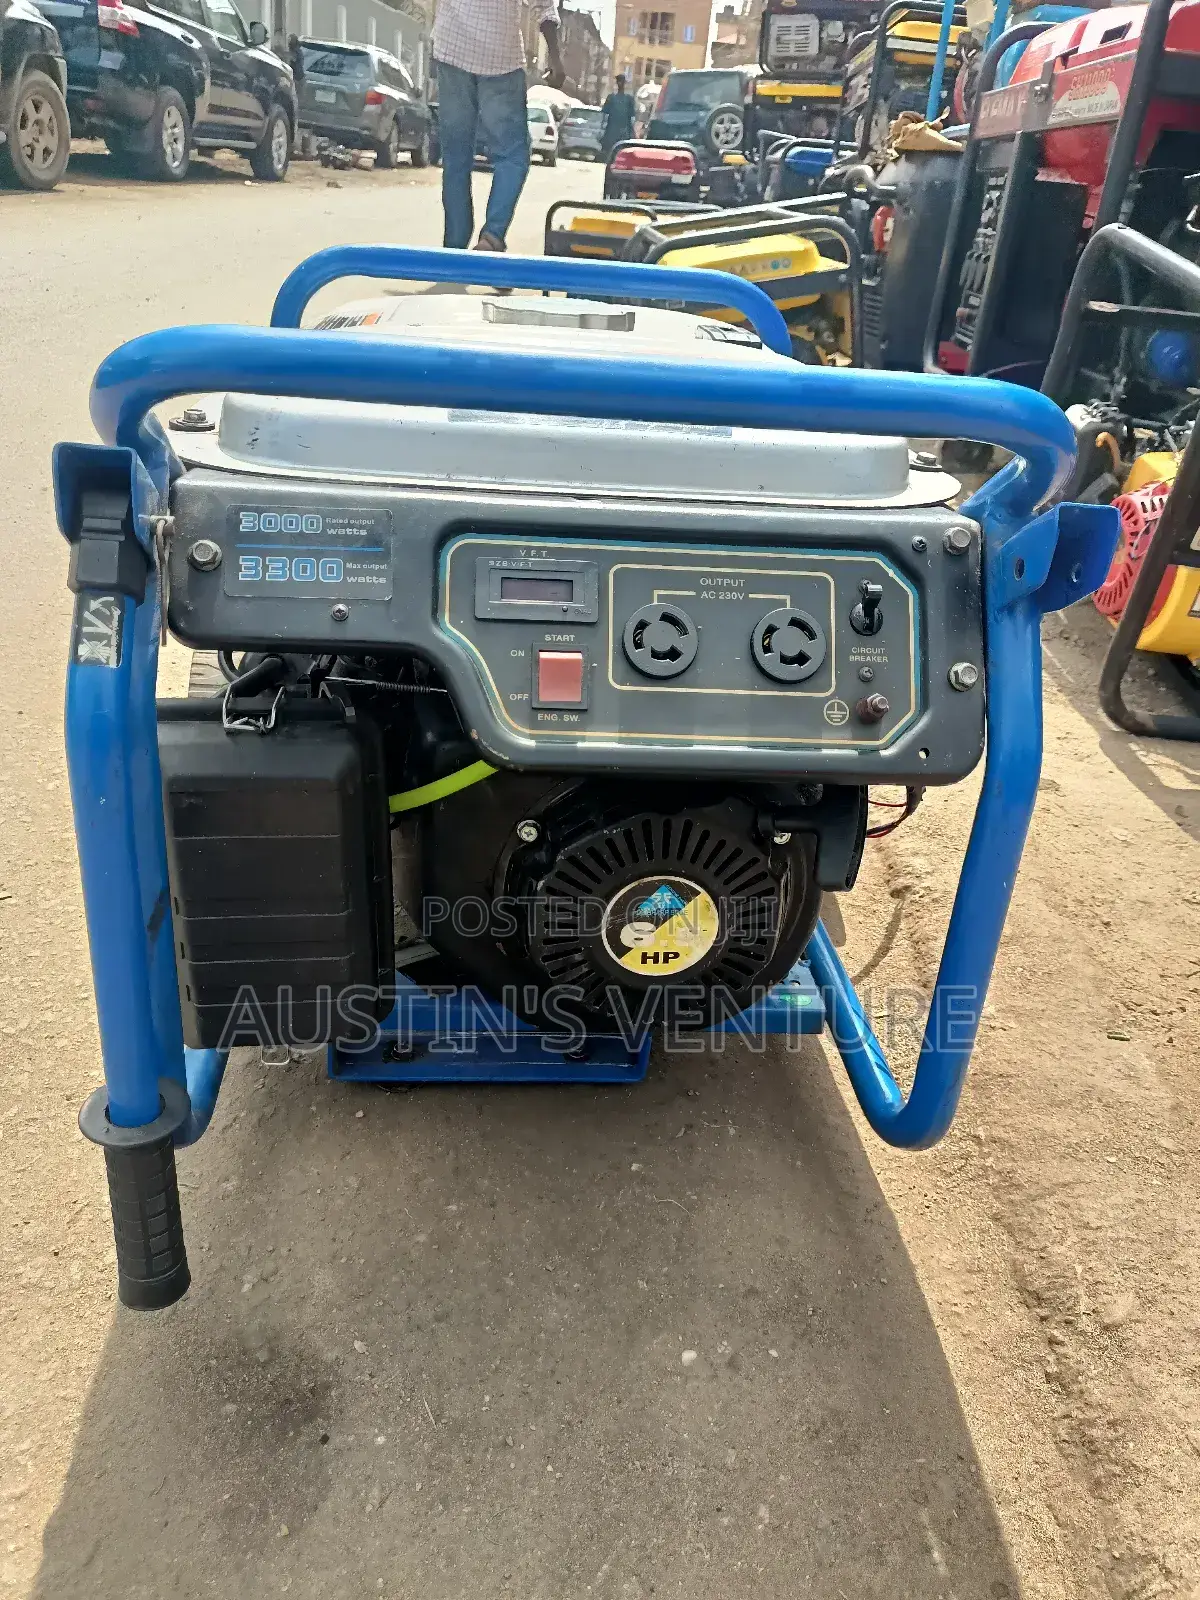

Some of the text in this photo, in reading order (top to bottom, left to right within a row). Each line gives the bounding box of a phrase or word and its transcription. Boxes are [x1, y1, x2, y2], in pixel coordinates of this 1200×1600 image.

[239, 511, 323, 534] 3000
[326, 517, 375, 526] Rated output
[326, 527, 368, 536] watts
[238, 556, 344, 583] 3300
[346, 562, 388, 571] Max output
[346, 575, 387, 584] watts
[700, 577, 745, 587] OUTPUT
[700, 591, 745, 601] AC 230V
[544, 634, 575, 642] START
[851, 646, 886, 655] CIRCUIT
[849, 654, 889, 663] BREAKER
[509, 693, 529, 701] OFF
[537, 713, 581, 722] ENG. SW.
[640, 951, 681, 965] HP
